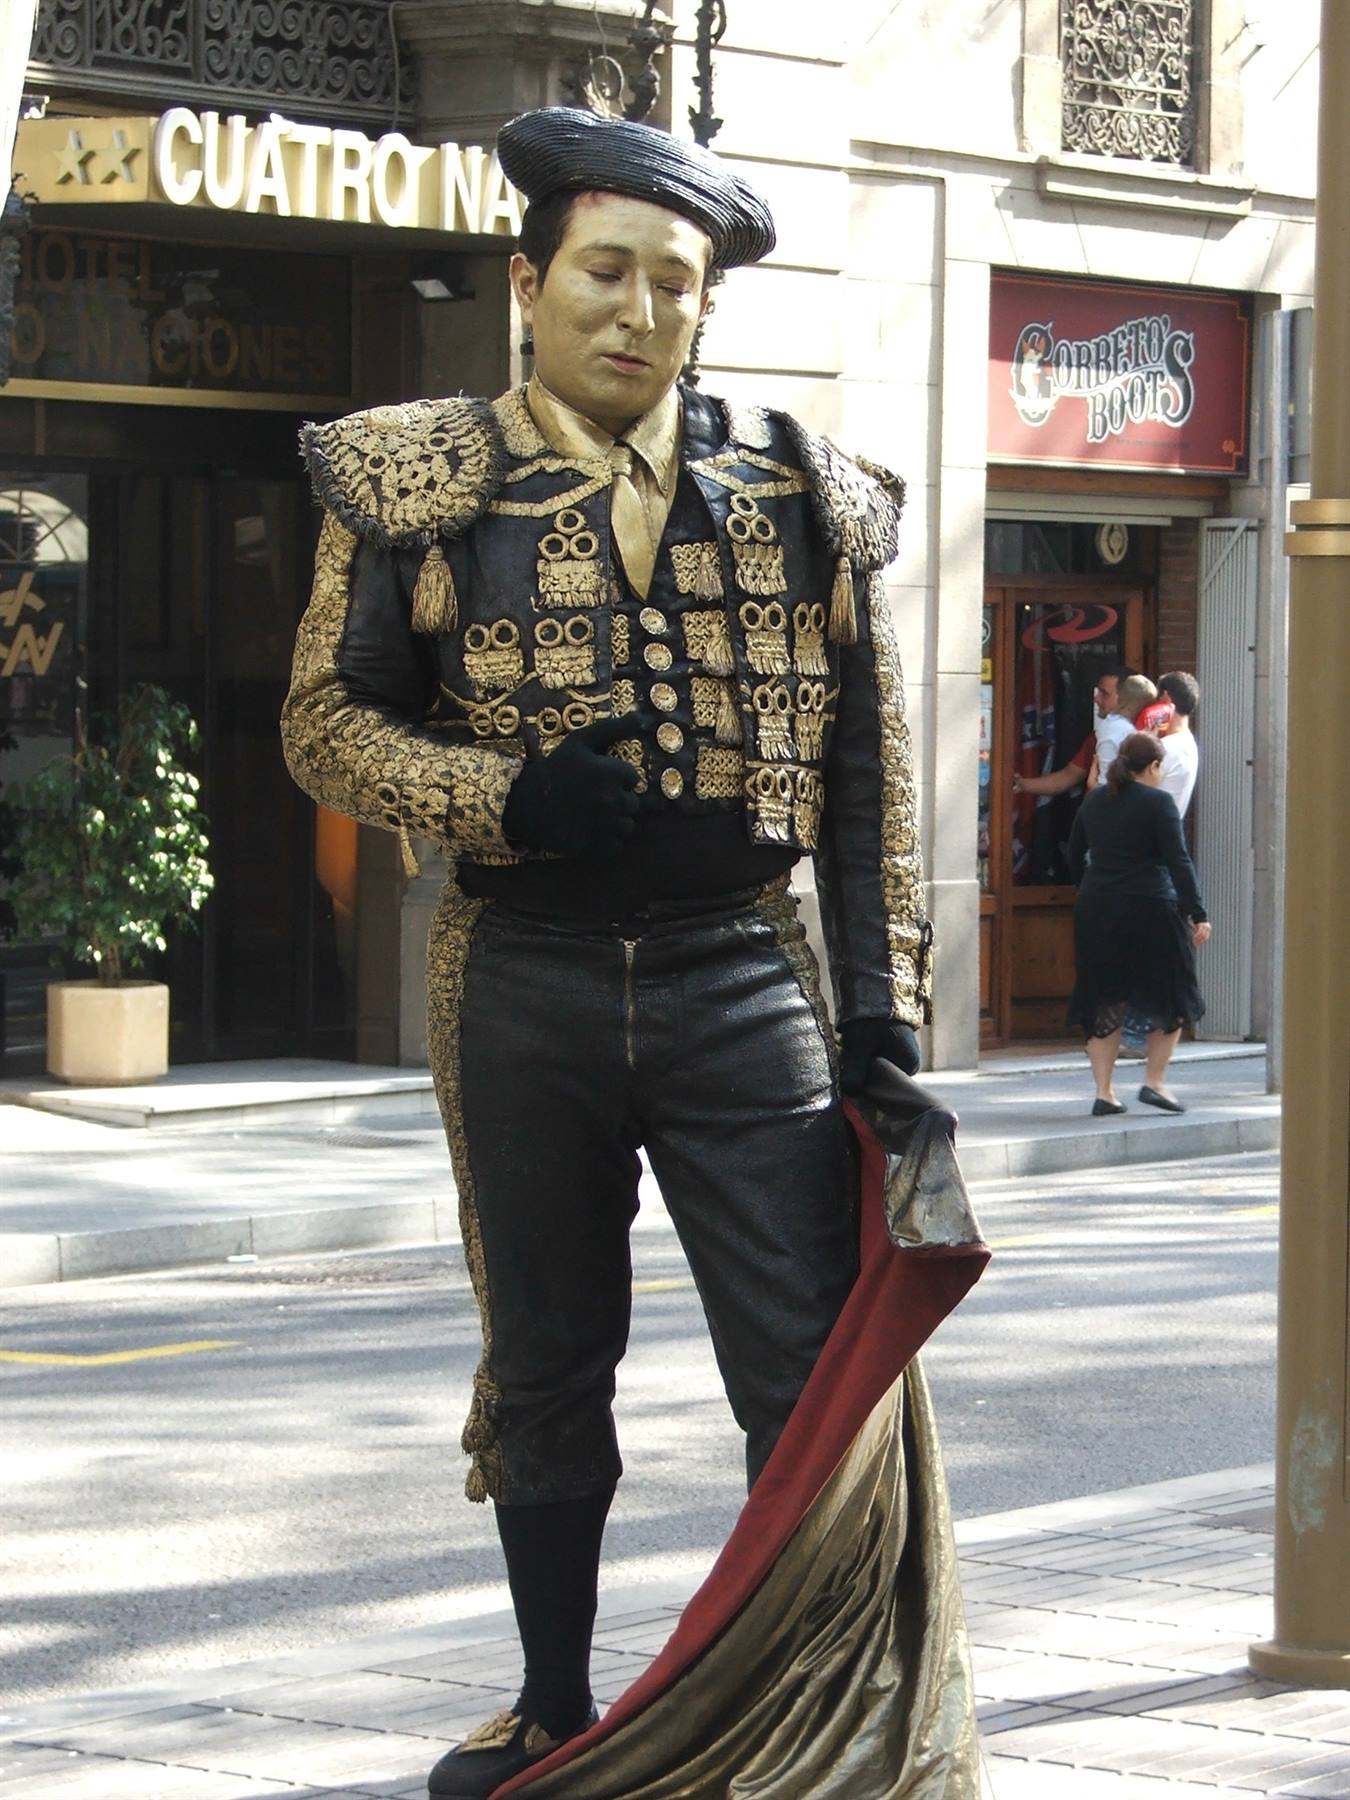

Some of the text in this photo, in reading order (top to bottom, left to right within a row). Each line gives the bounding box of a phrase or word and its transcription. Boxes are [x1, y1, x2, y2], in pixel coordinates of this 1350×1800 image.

[154, 107, 412, 228] CUATRO
[78, 307, 338, 385] NACIONES
[1087, 366, 1194, 443] BOOTS
